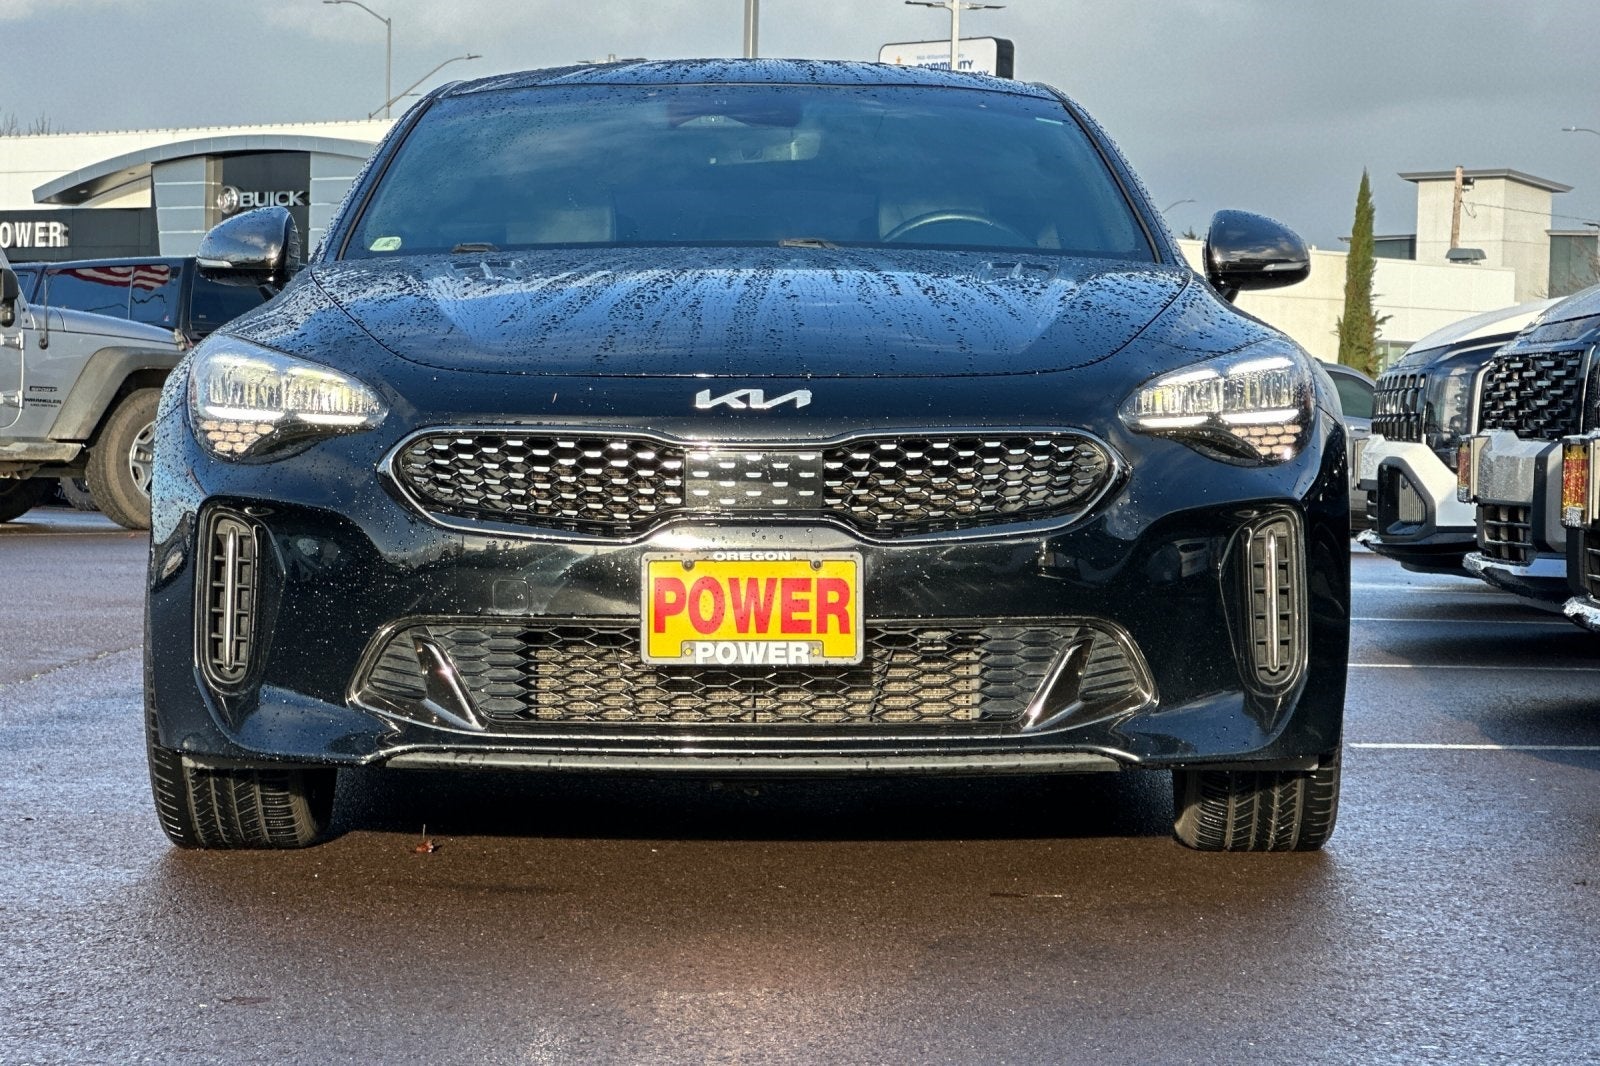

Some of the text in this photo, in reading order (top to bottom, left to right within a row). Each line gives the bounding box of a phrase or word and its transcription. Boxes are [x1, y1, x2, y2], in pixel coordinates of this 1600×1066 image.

[917, 60, 974, 70] COMMUITY
[239, 190, 305, 207] BUICK
[695, 388, 813, 409] KIA
[712, 551, 791, 562] OREGON
[653, 576, 851, 635] POWER
[695, 642, 810, 665] POWER
